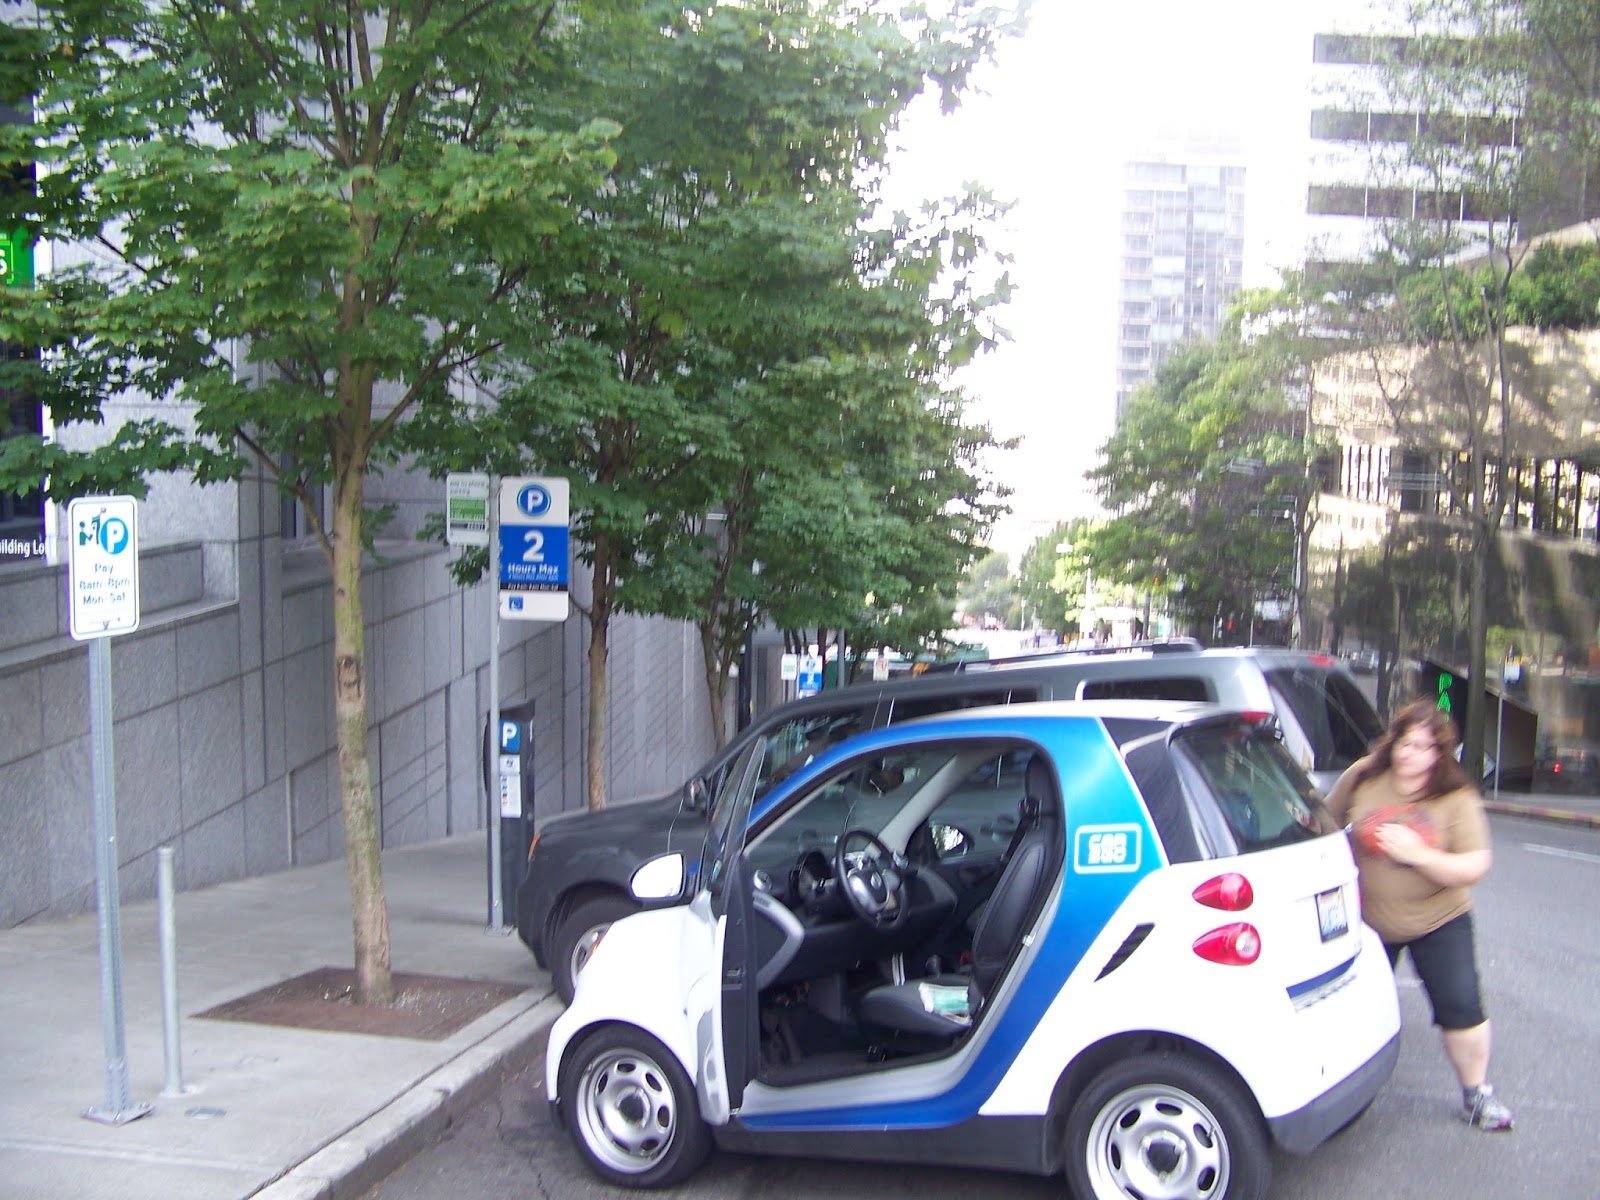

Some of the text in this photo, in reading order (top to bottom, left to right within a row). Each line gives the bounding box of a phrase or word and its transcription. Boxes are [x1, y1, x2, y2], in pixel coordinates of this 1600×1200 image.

[527, 490, 544, 513] P
[106, 520, 125, 553] P
[522, 530, 545, 562] 2
[0, 539, 30, 558] ilding
[94, 562, 114, 575] Pay
[508, 562, 559, 575] Hours Max
[502, 721, 518, 748] P
